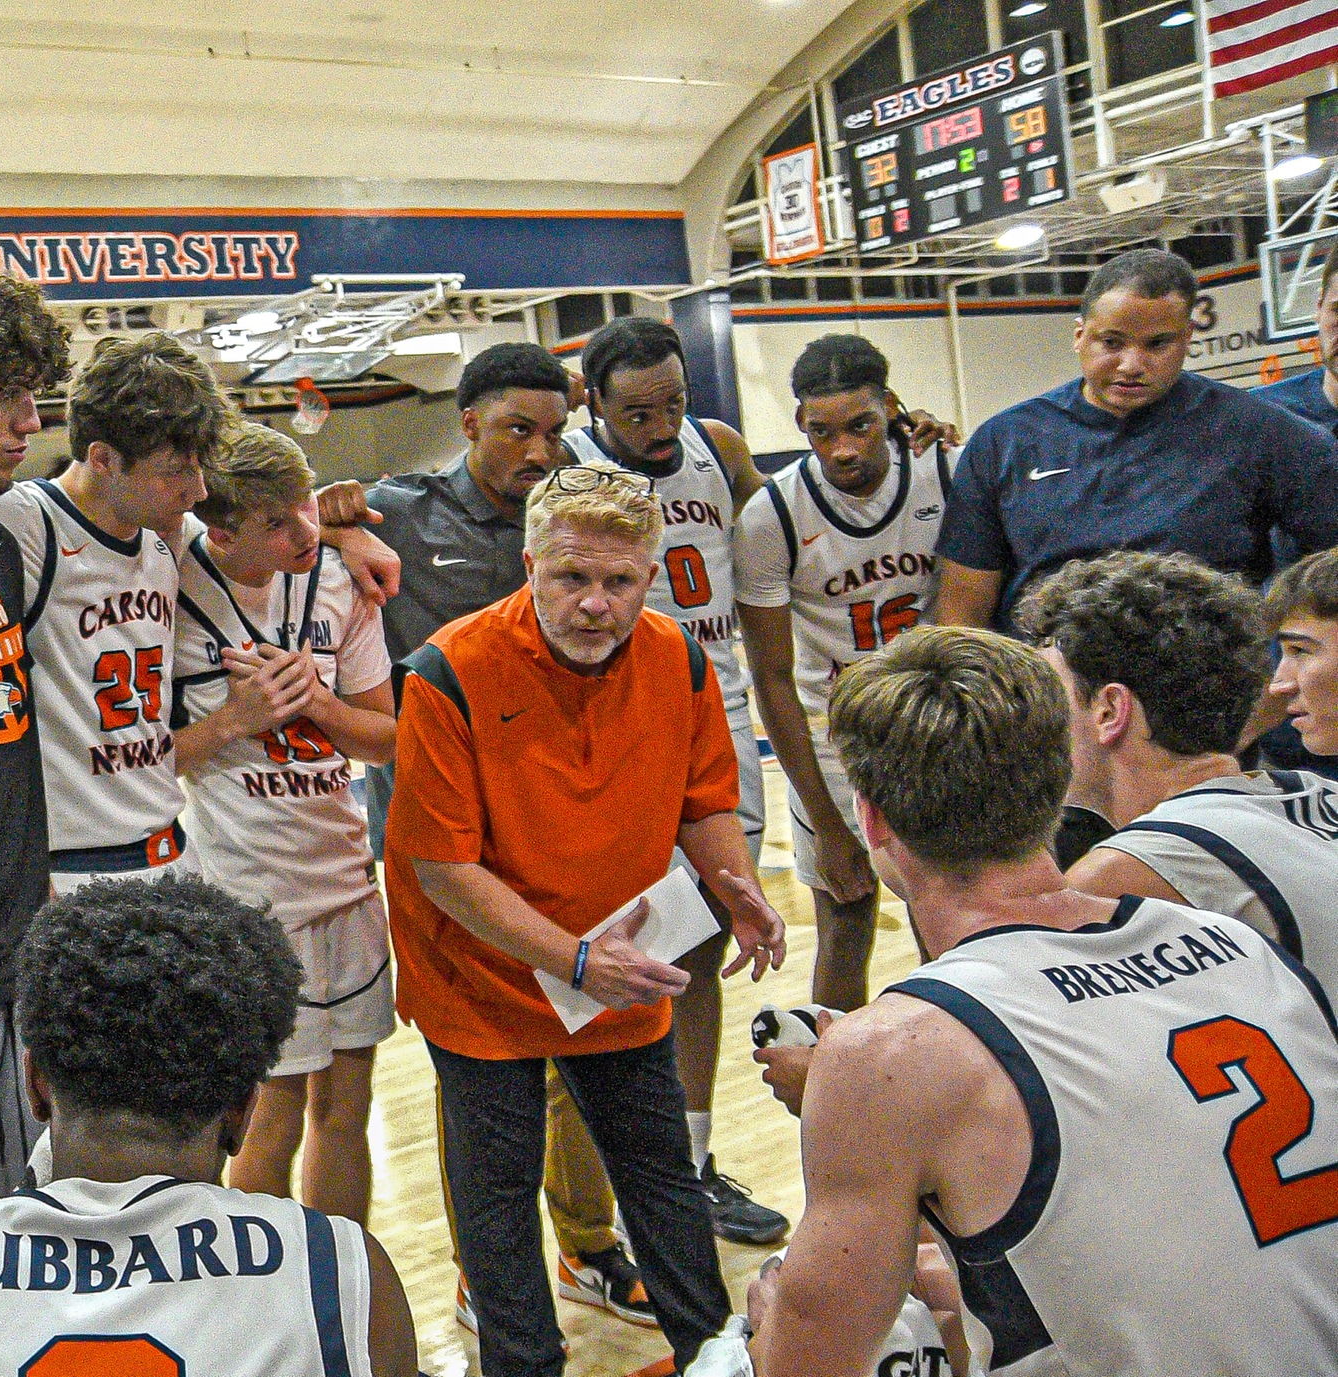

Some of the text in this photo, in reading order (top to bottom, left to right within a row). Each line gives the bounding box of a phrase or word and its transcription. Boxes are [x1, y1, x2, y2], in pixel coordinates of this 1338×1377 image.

[873, 54, 1016, 127] EAGLES
[1009, 105, 1047, 144] 58
[866, 152, 898, 187] 32
[959, 148, 976, 173] 2
[1003, 177, 1020, 202] 2
[893, 208, 910, 232] 2
[664, 544, 712, 609] 0
[824, 551, 938, 597] CARSON
[92, 645, 164, 732] 25
[1039, 924, 1249, 1004] BRENEGAN
[1166, 1014, 1338, 1249] 2
